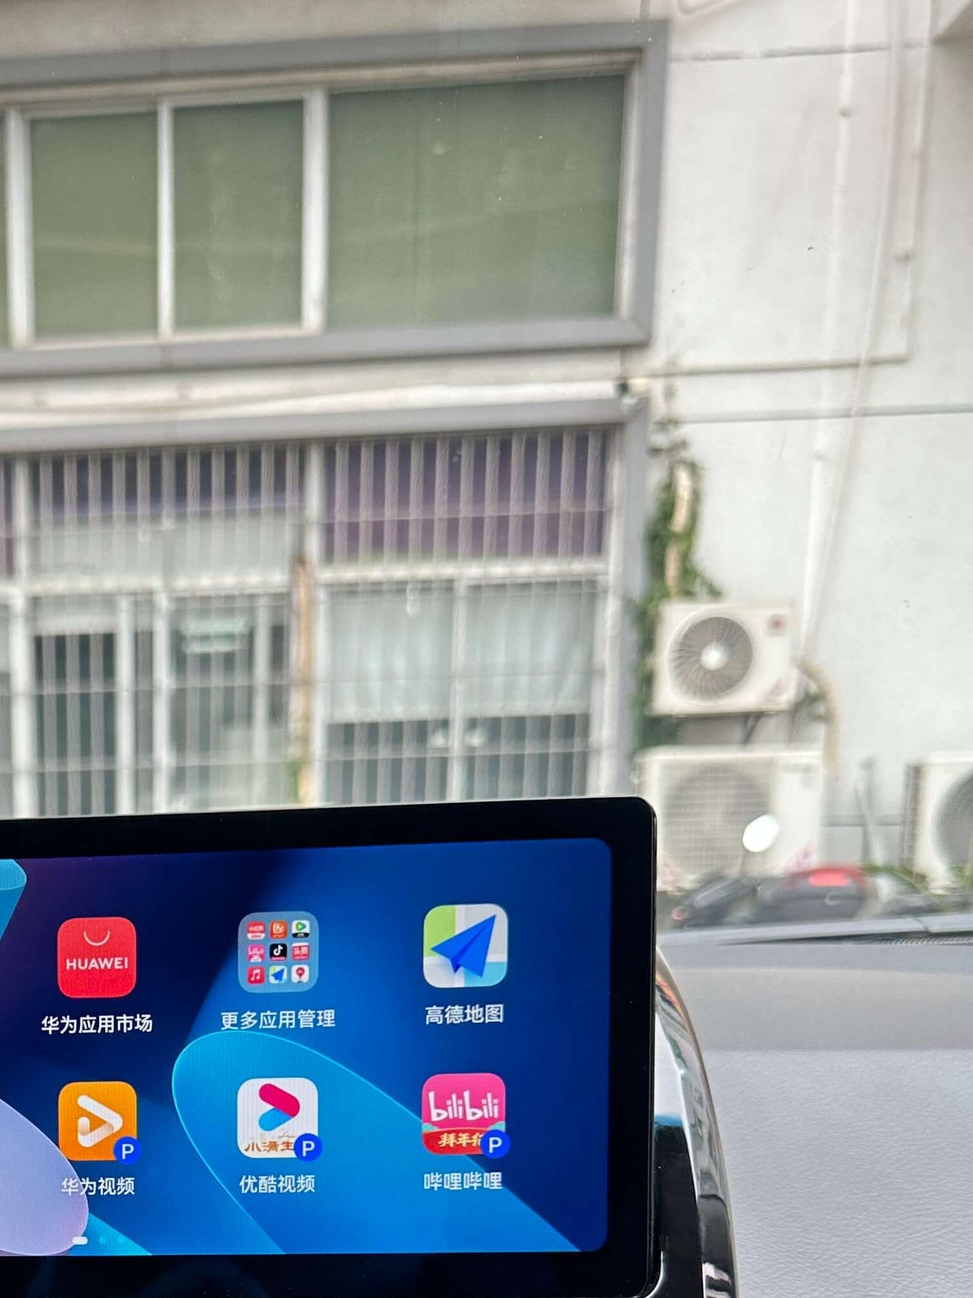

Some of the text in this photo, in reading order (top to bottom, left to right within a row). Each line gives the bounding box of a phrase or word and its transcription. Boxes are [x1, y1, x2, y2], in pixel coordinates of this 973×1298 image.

[66, 957, 128, 971] HUAWEI
[221, 1009, 336, 1030] 更多应用管理
[425, 1004, 504, 1024] 高德地图
[41, 1014, 153, 1035] 华为应用市场
[428, 1090, 499, 1122] bilibili
[121, 1143, 134, 1159] P
[302, 1140, 315, 1157] P
[489, 1136, 502, 1153] P
[61, 1176, 135, 1196] 华为视频
[239, 1174, 315, 1193] 优酷视频
[423, 1172, 502, 1190] 哔哩哔哩
